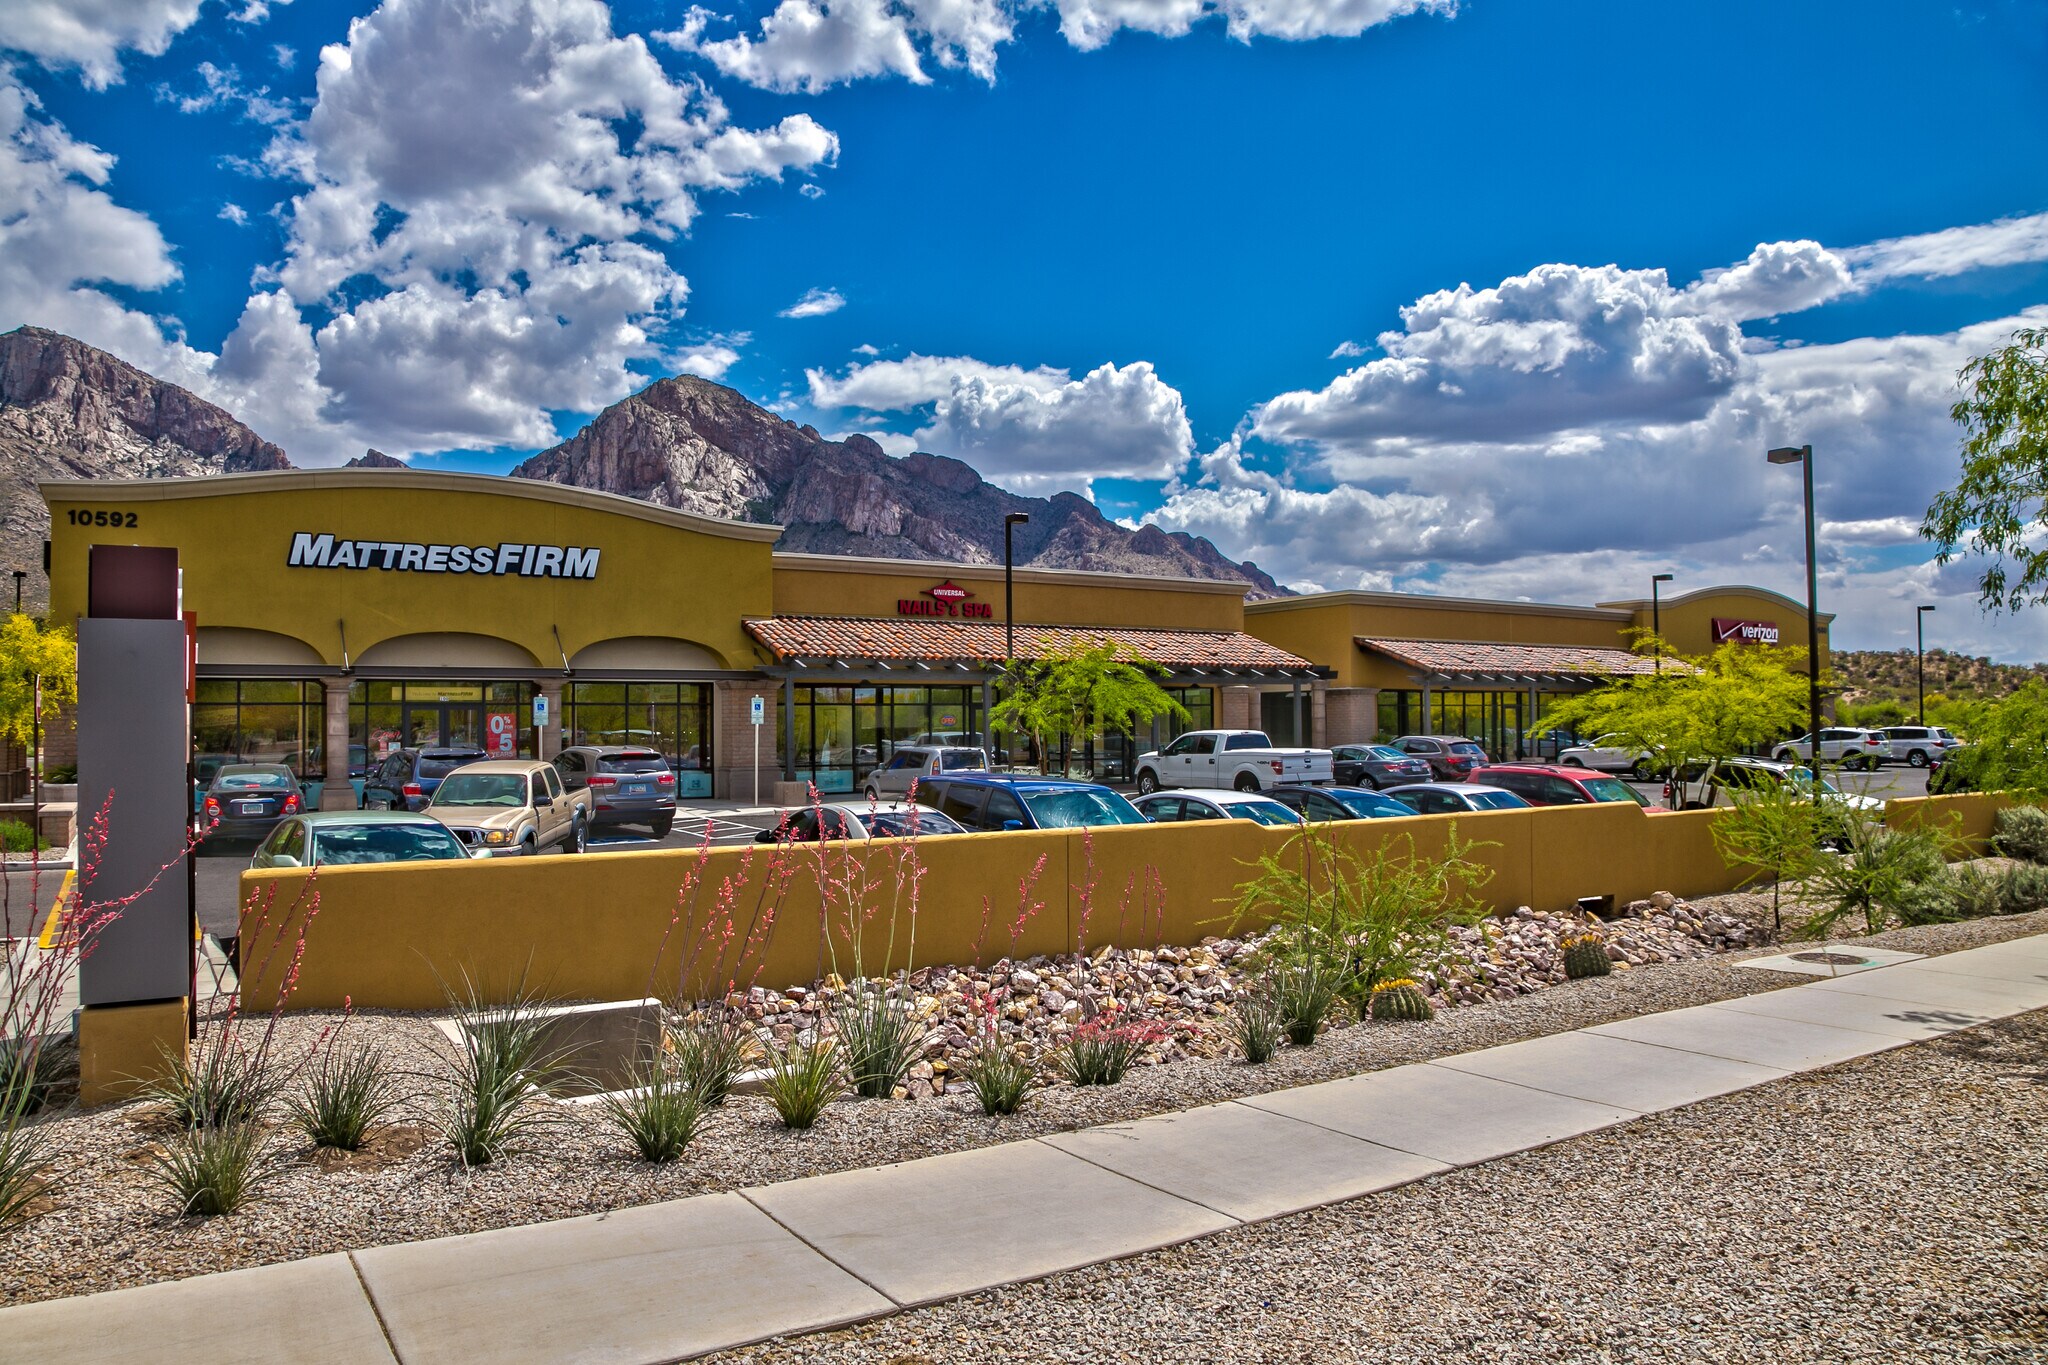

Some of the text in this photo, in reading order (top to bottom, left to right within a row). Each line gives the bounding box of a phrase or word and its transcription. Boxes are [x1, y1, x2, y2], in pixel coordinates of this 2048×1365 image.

[67, 509, 138, 528] 10592
[288, 532, 601, 579] MATTRESSFIRM
[933, 589, 965, 597] UNIVERSAL
[898, 599, 993, 618] NAILS & SPA
[1741, 623, 1779, 643] verizon
[490, 715, 511, 735] 0%
[940, 717, 956, 725] OPEN
[499, 733, 513, 752] 5
